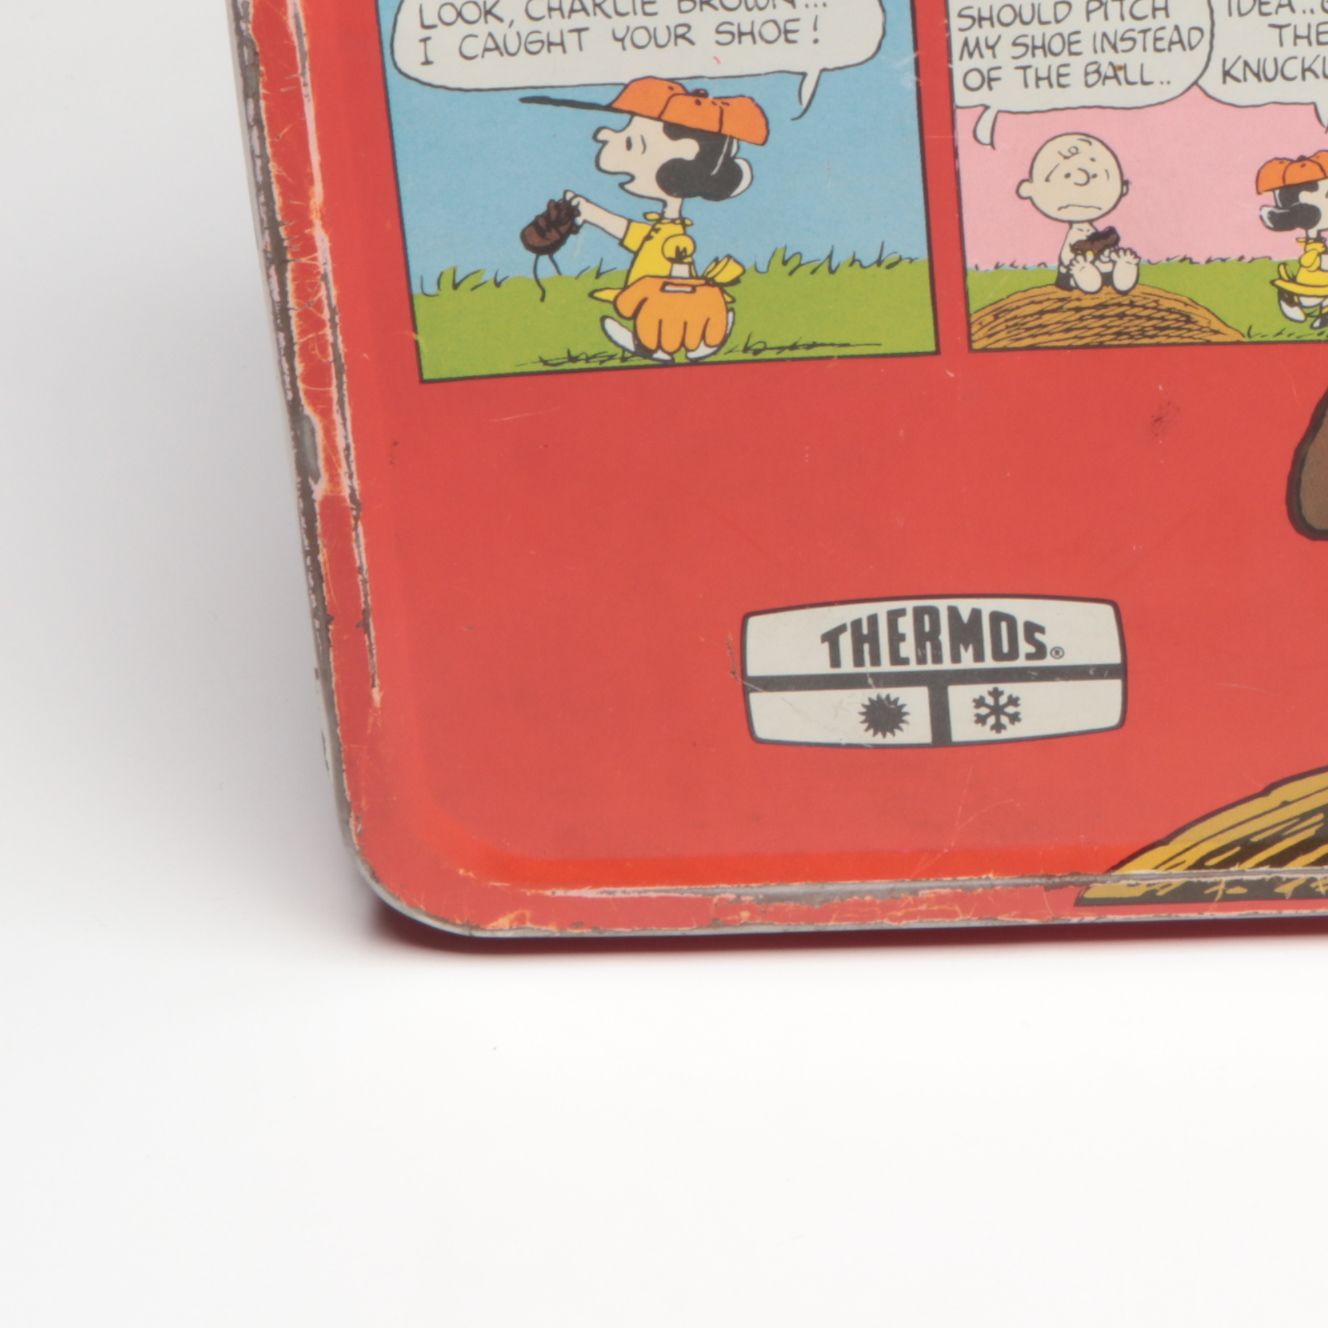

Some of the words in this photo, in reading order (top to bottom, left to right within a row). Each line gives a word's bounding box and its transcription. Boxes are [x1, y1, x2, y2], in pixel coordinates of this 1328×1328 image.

[418, 0, 515, 30] LOOK,
[957, 0, 1073, 32] SHOULD
[418, 35, 434, 66] I
[458, 26, 590, 61] CAUGHT
[612, 23, 696, 52] YOUR
[714, 14, 820, 47] SHOE!
[959, 33, 1003, 62] MY
[1011, 30, 1082, 60] SHOE
[1093, 24, 1205, 55] INSTEAD
[963, 66, 1003, 93] OF
[1014, 64, 1075, 91] THE
